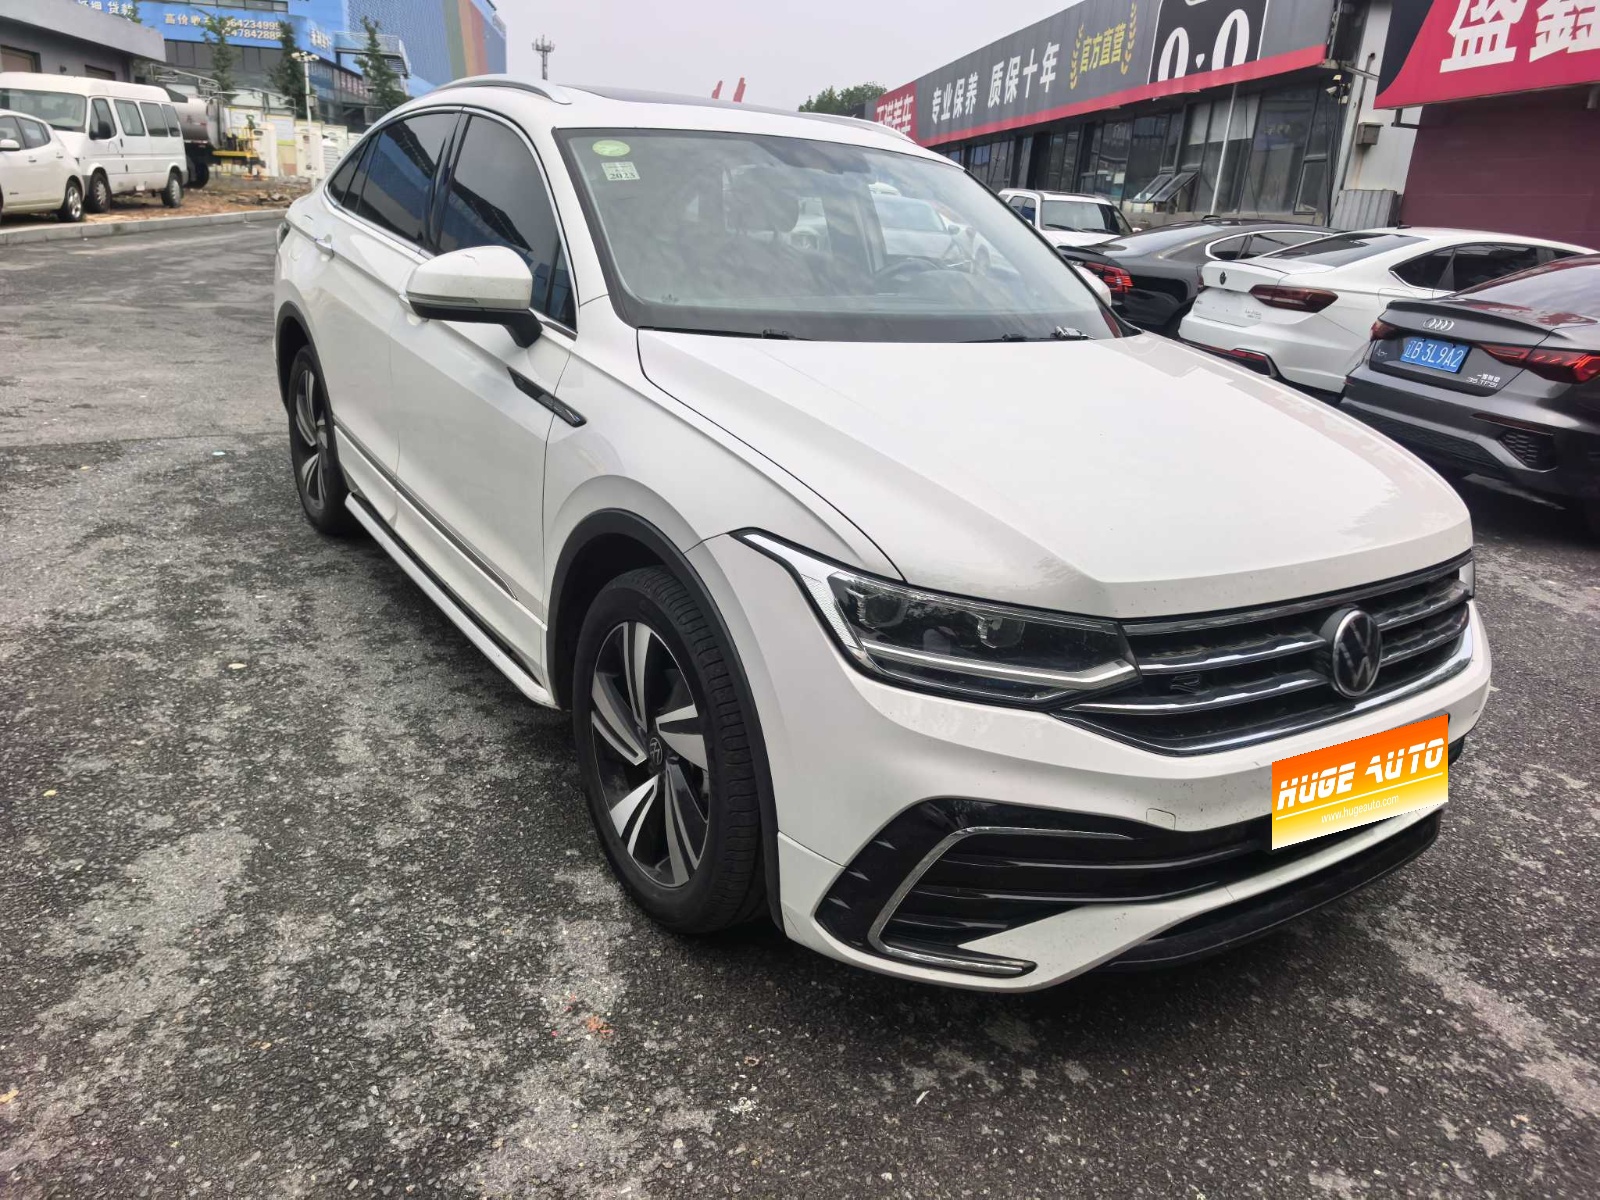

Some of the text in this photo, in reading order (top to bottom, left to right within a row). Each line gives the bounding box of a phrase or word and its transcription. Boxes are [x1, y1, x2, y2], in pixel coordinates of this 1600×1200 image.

[1080, 23, 1126, 73] 官方直营
[932, 42, 1060, 125] 专业保养 质保十年
